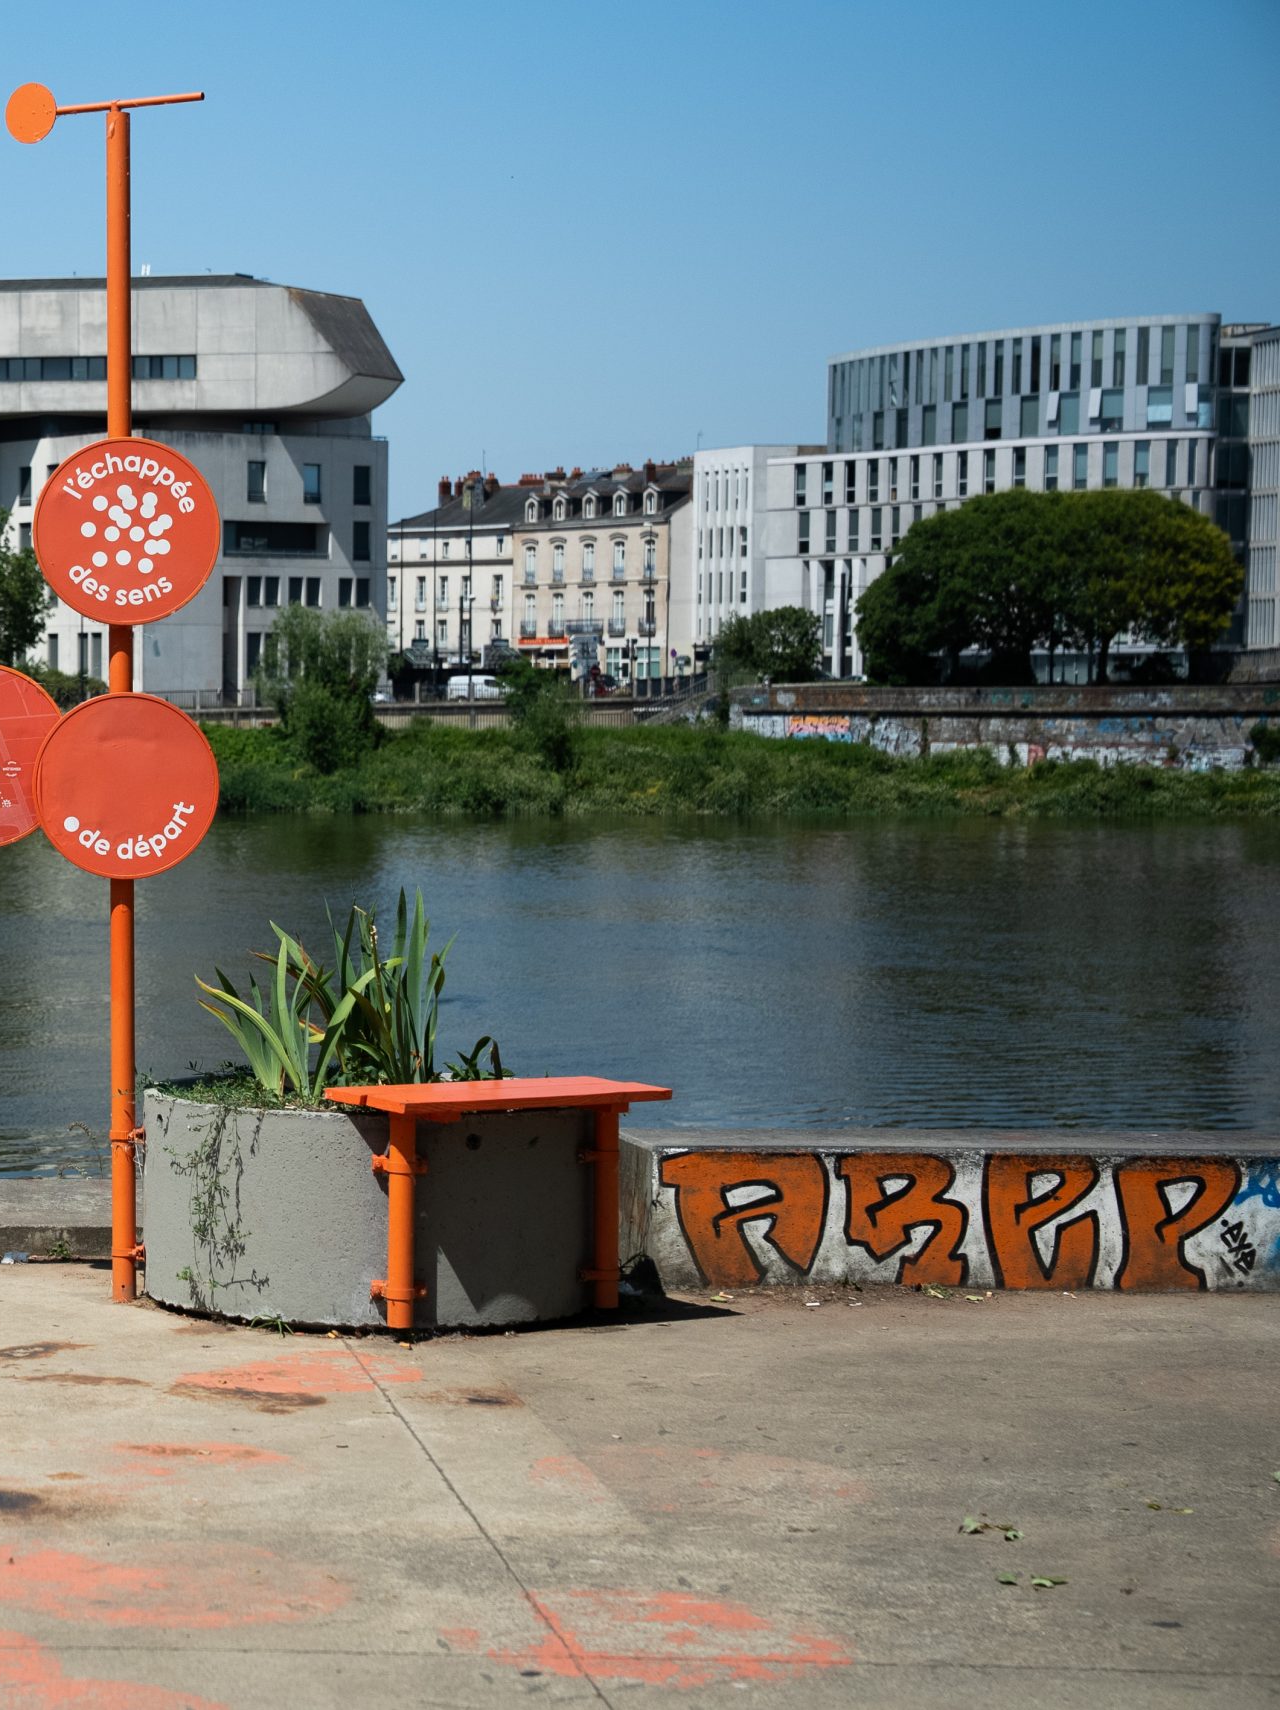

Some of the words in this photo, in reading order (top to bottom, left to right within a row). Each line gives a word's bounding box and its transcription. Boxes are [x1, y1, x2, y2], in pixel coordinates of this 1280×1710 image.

[62, 452, 195, 514] l'échappée
[69, 565, 110, 602] des
[115, 576, 173, 606] sens
[78, 829, 111, 856] de
[116, 802, 195, 860] départ
